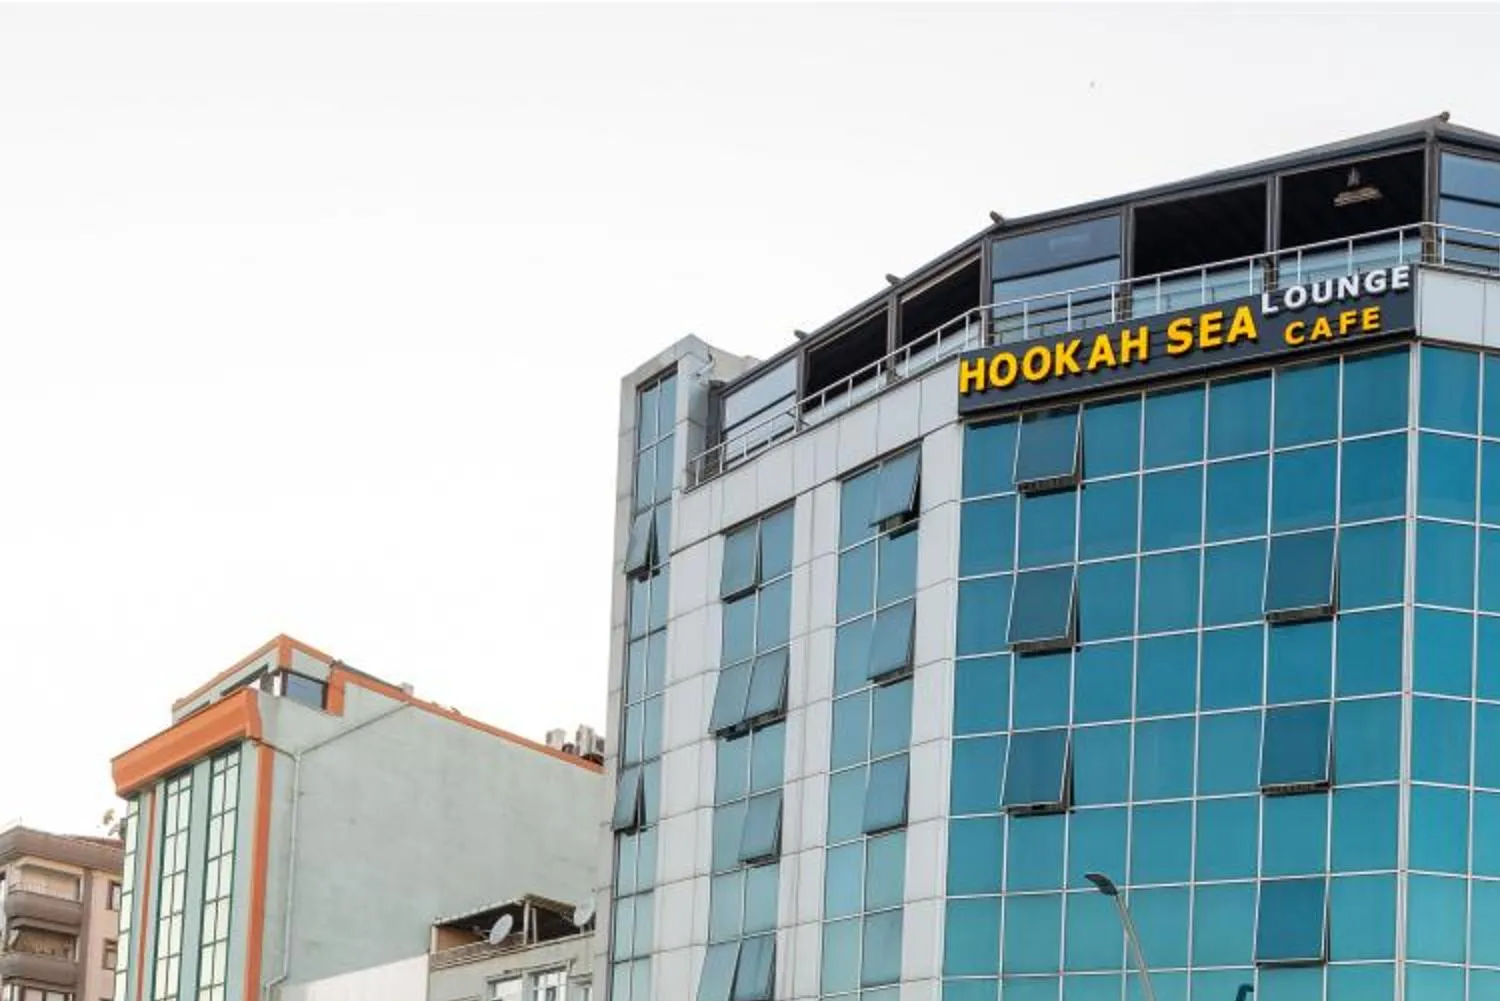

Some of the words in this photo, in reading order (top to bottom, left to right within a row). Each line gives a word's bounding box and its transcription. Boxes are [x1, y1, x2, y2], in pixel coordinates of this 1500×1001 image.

[1261, 265, 1410, 315] LOUNGE
[959, 325, 1149, 394] HOOKAH
[1167, 304, 1259, 356] SEA
[1284, 306, 1382, 346] CAFE
